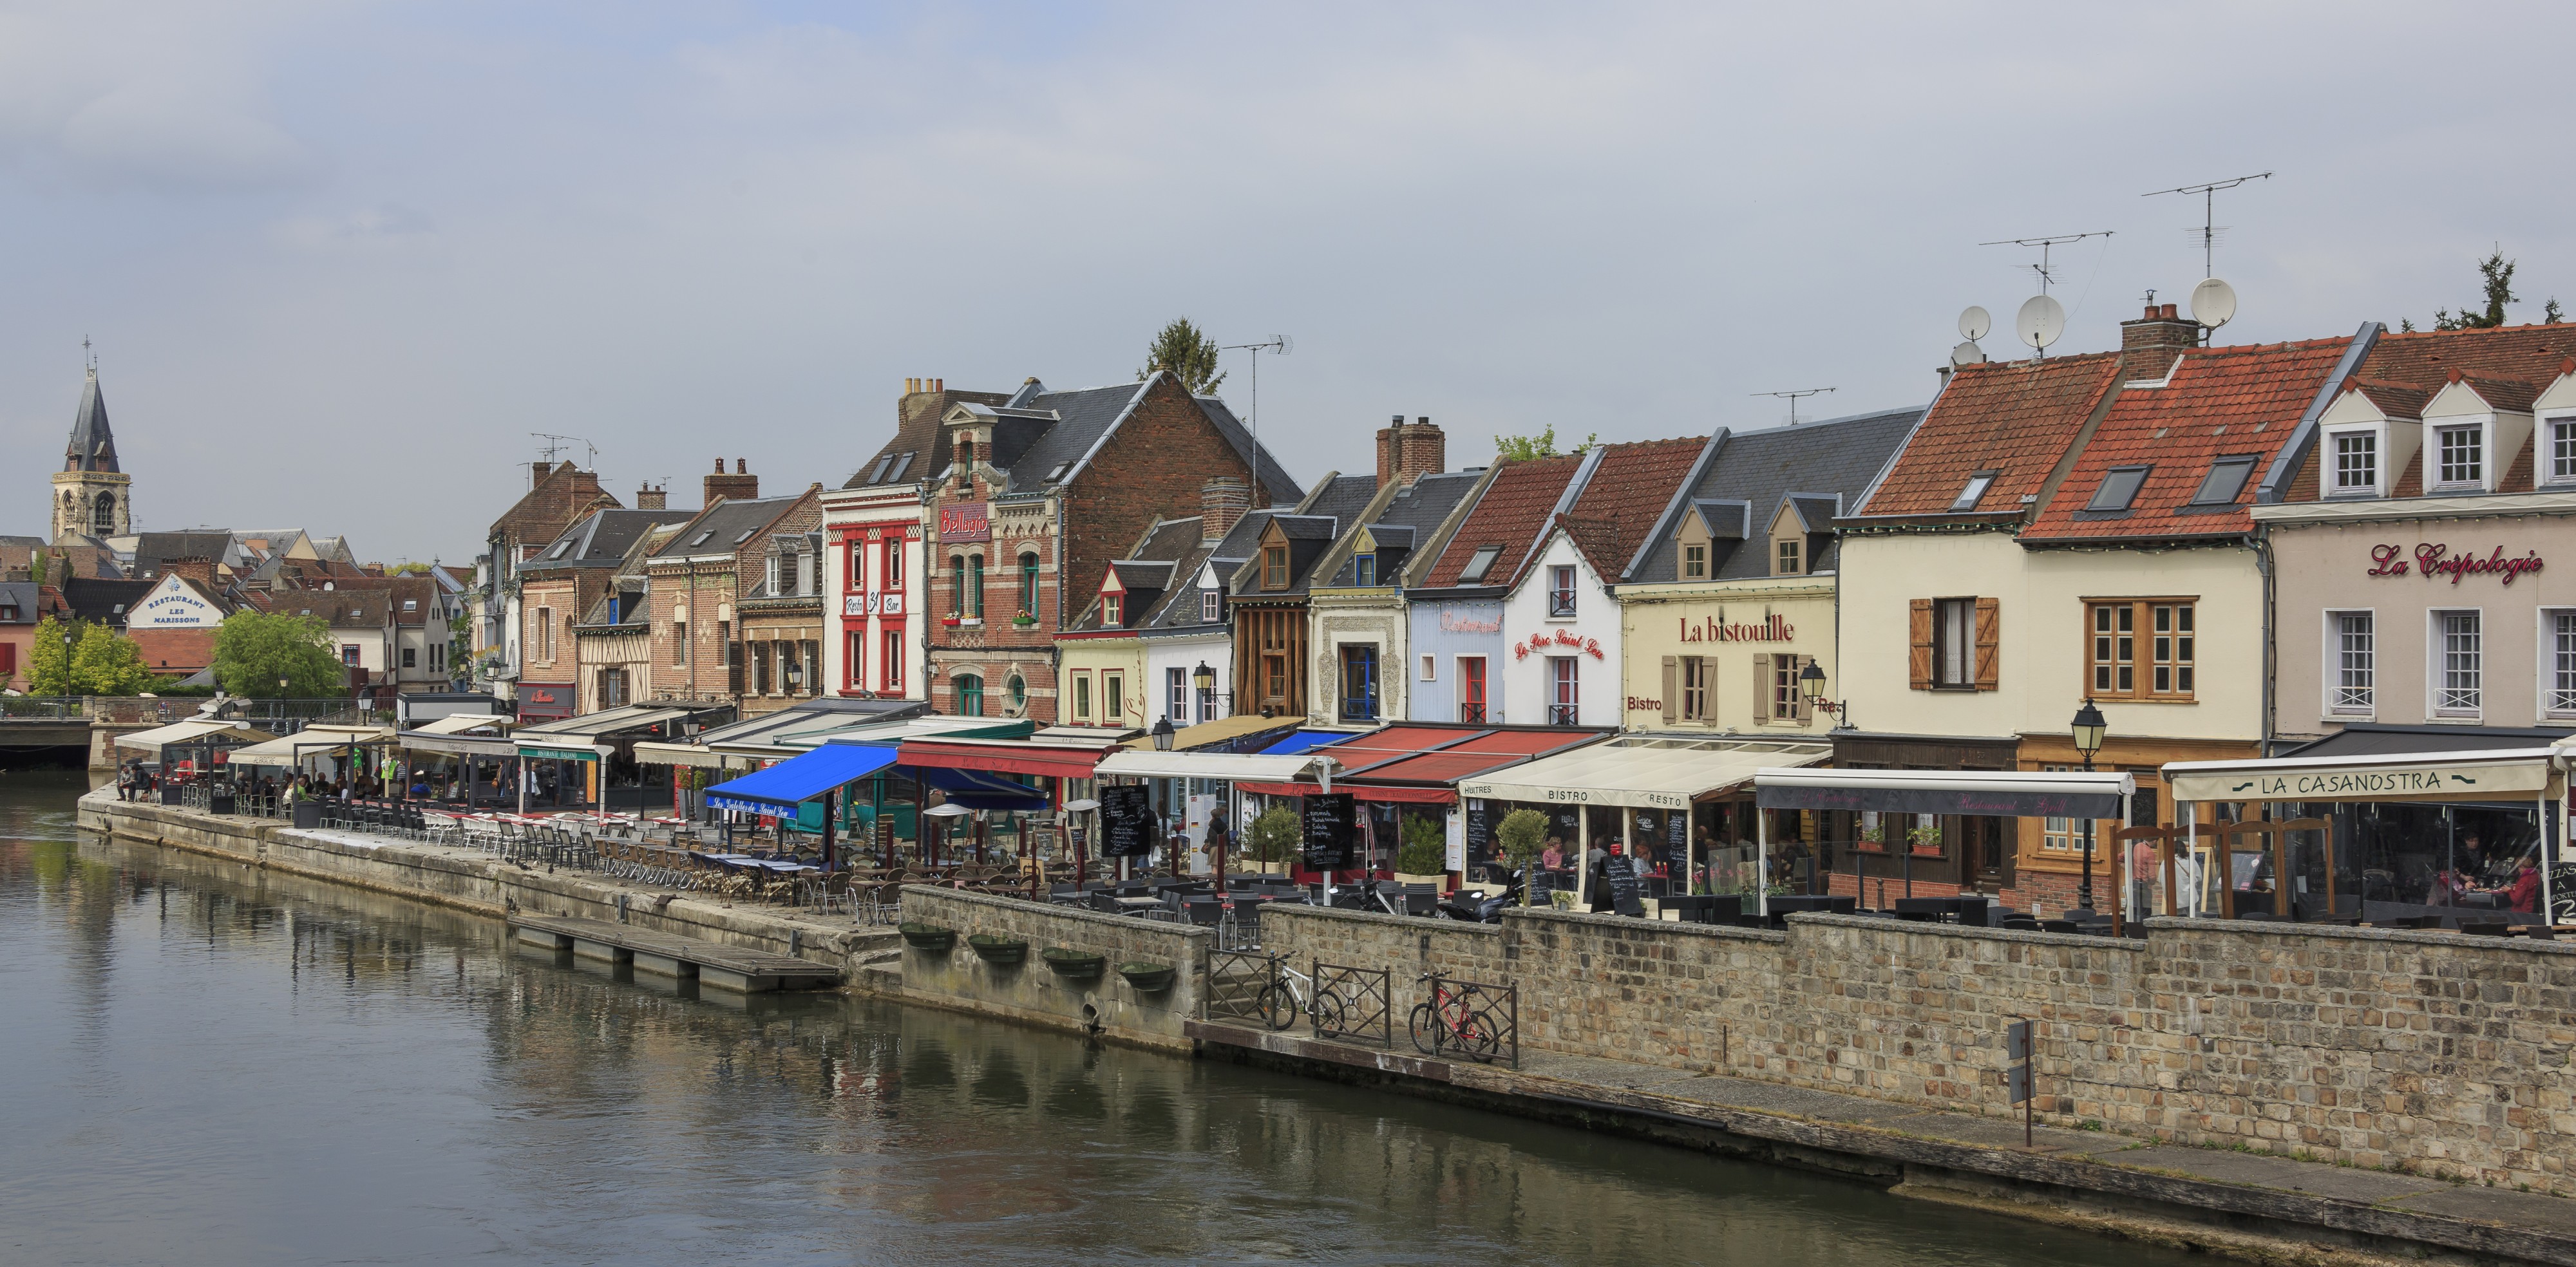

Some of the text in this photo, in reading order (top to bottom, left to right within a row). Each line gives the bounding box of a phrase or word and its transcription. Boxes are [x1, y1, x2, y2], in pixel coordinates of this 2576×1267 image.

[941, 509, 988, 537] Bellagio
[2367, 543, 2544, 585] La Crêpologie
[148, 596, 205, 609] RESTAURANT
[846, 599, 862, 613] Resto
[869, 591, 880, 612] 31
[886, 598, 900, 612] Bar
[1440, 612, 1502, 633] Restaurant
[1680, 608, 1794, 642] La bistouille
[1515, 629, 1604, 659] Le Porc Saint Leu
[1627, 697, 1662, 710] Bistro
[2262, 771, 2440, 794] LA CASANOSTRA
[714, 796, 788, 817] Les Galettes de Saint Leu
[1464, 786, 1681, 807] HUITRES BISTRO RESTO
[1956, 793, 2067, 814] Restaurant Grill
[2557, 881, 2566, 890] A
